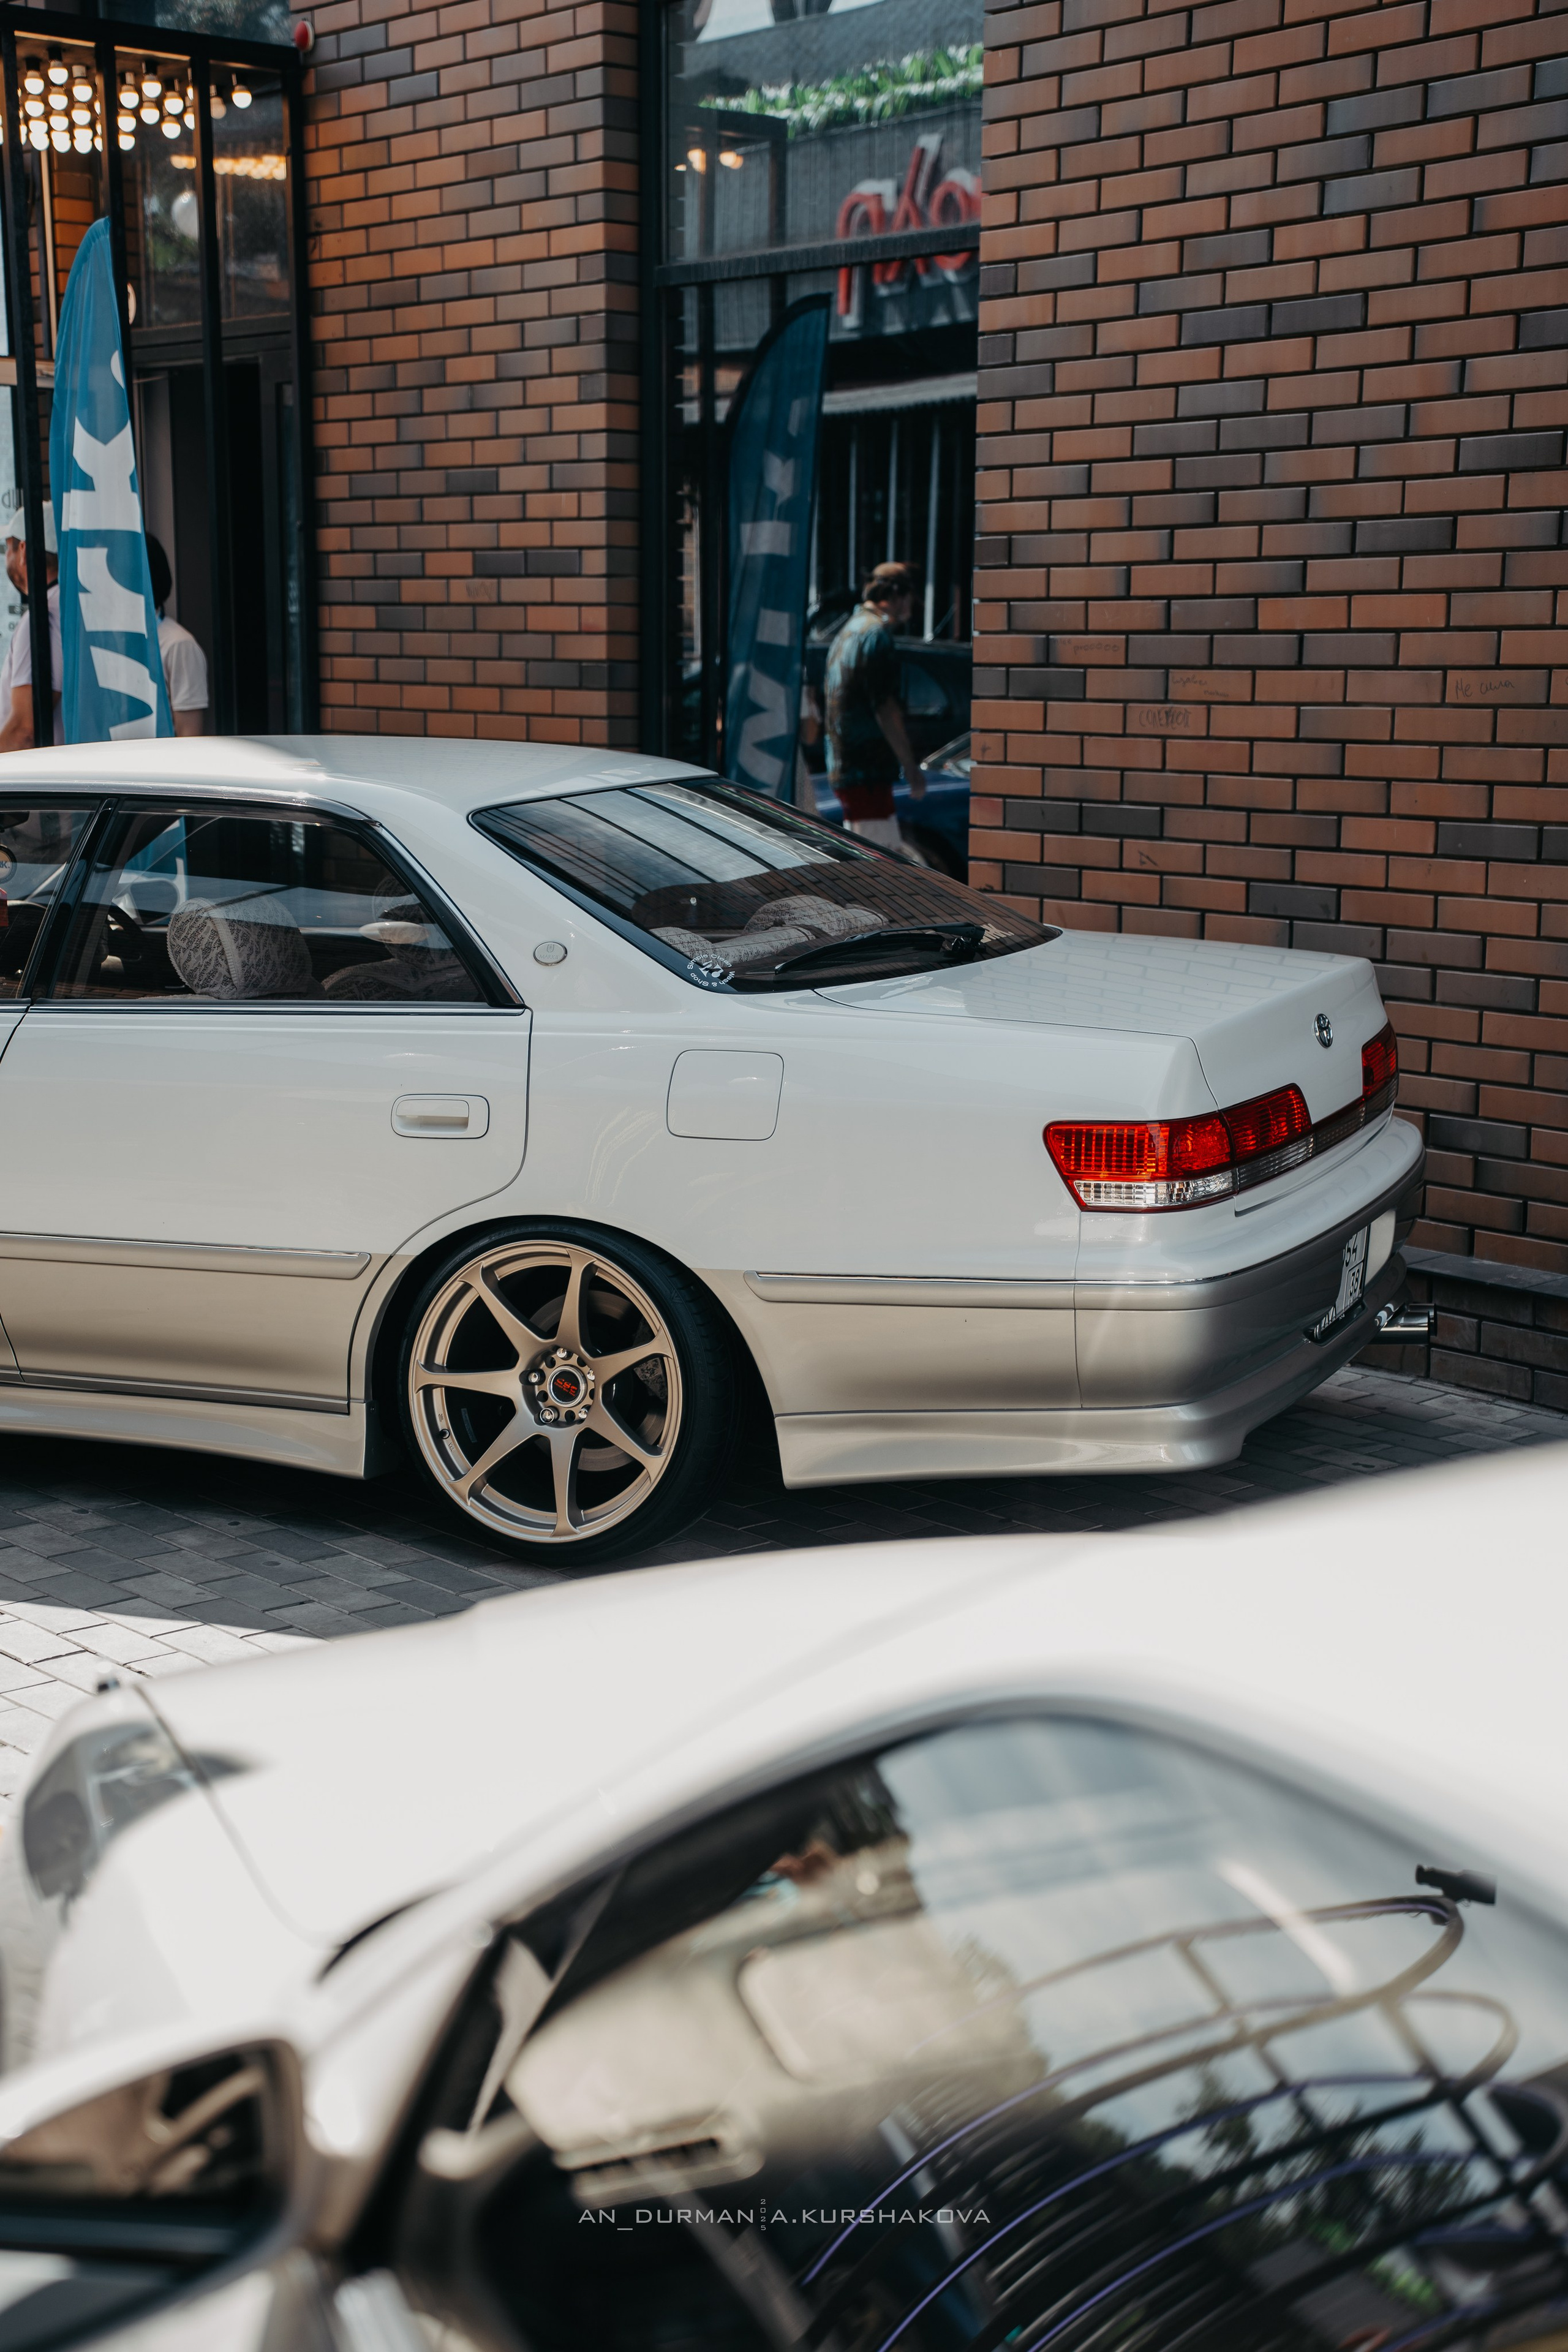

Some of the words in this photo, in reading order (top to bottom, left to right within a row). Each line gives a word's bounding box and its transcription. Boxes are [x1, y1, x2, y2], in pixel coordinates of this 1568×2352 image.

[687, 954, 708, 970] Simple
[710, 954, 732, 967] Clean
[690, 973, 709, 986] Shop
[718, 971, 736, 985] Wash
[1349, 1267, 1360, 1297] 38
